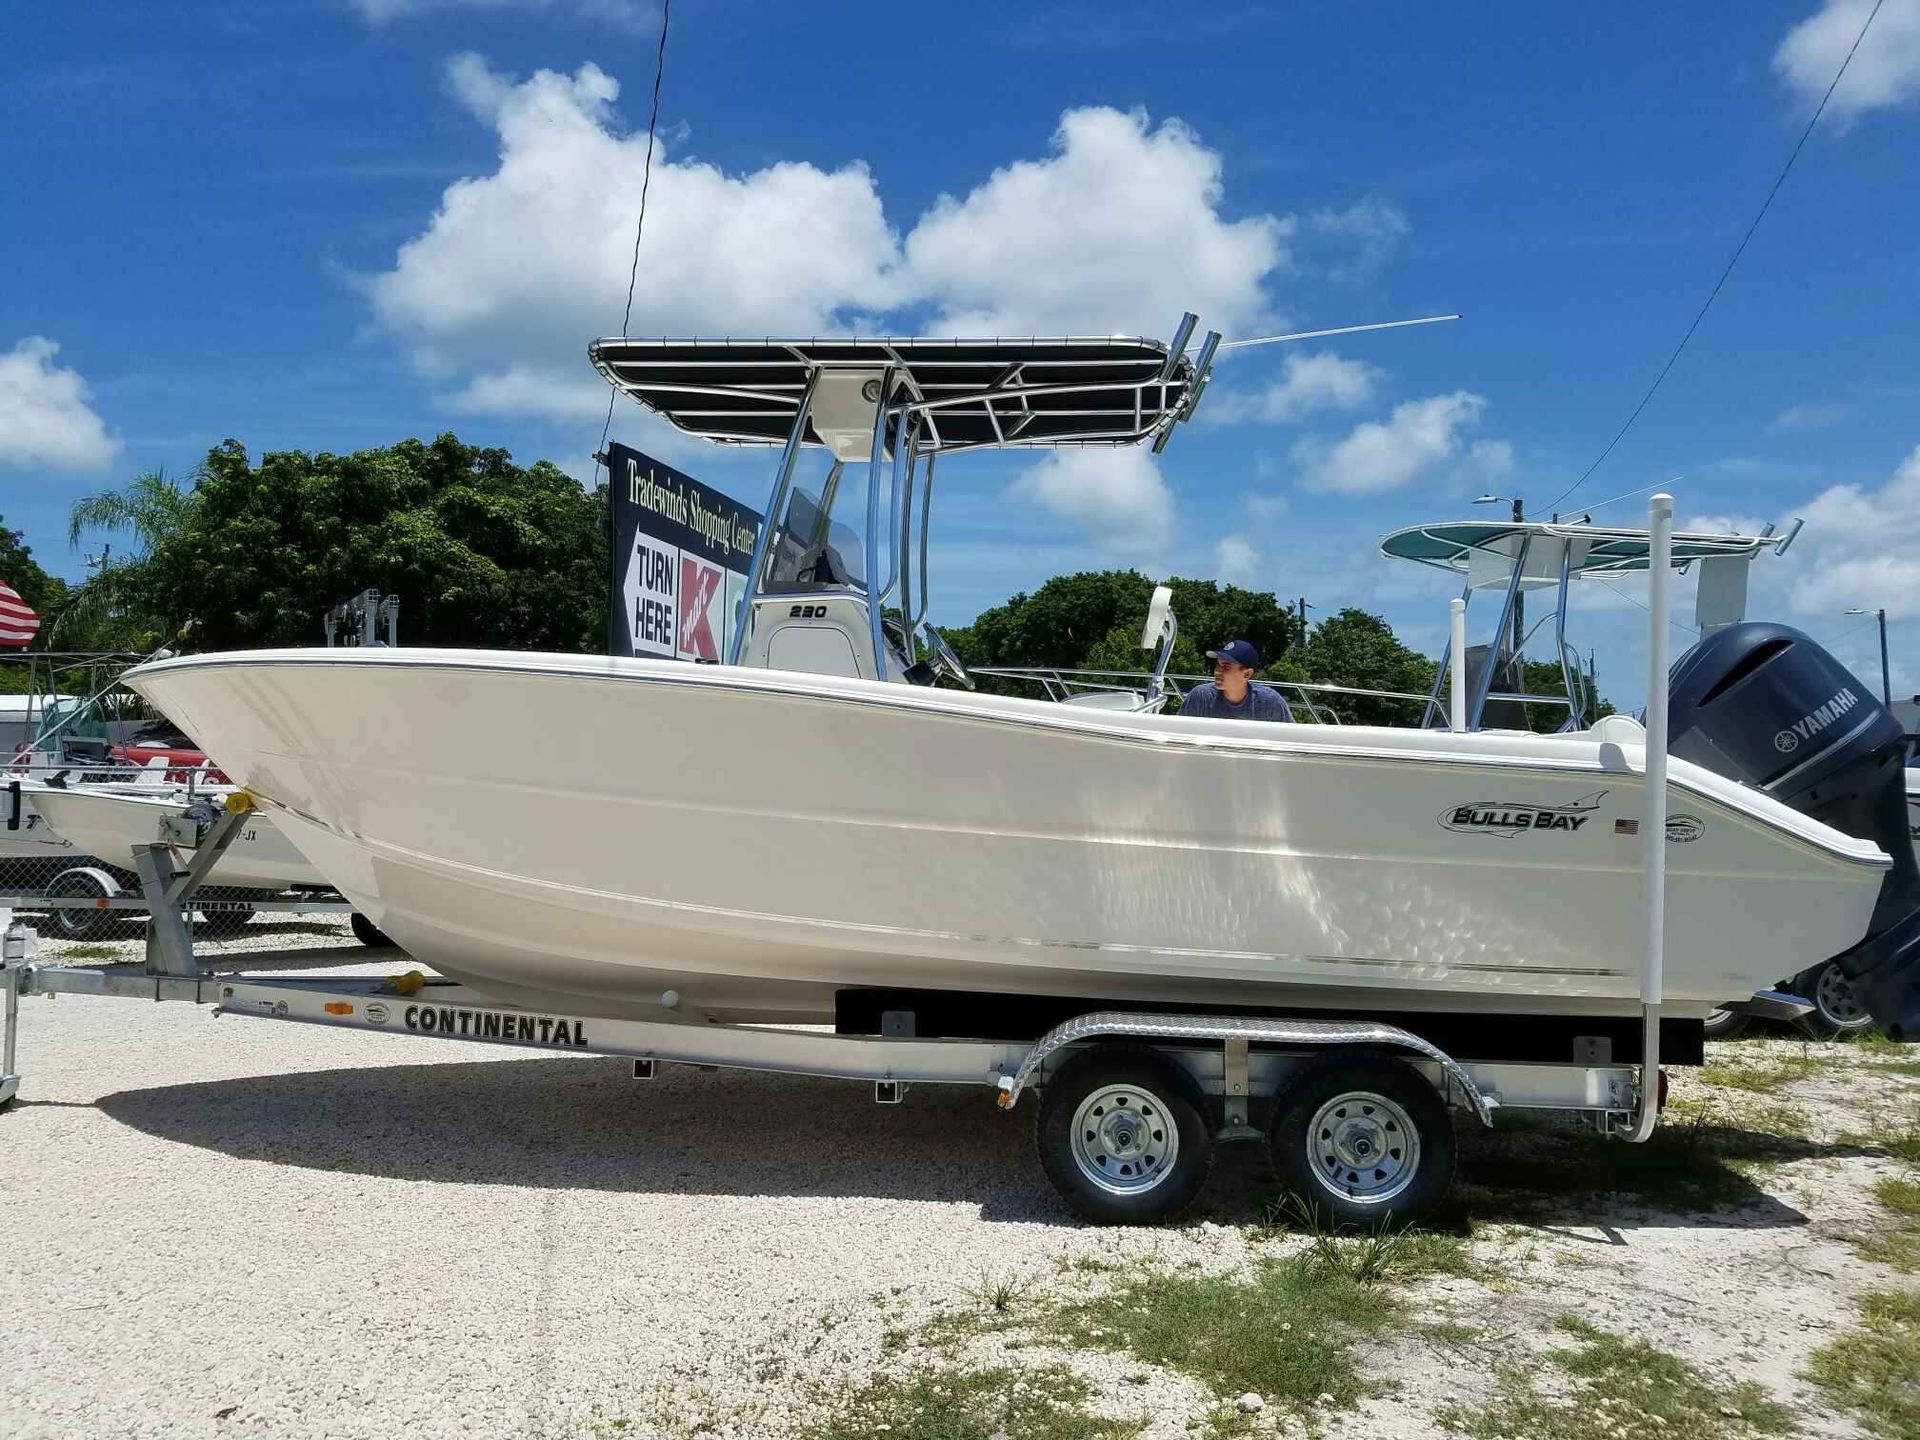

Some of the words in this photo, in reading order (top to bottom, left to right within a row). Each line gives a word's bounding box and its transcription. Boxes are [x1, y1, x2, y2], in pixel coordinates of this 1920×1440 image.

[627, 458, 688, 526] Tradewinds
[690, 489, 731, 555] Shopping
[732, 511, 756, 556] Center
[636, 544, 674, 597] TURN
[635, 596, 672, 646] HERE
[789, 605, 827, 618] 230
[1792, 687, 1859, 740] YAMAHA
[1451, 807, 1532, 828] BULLS
[1533, 811, 1588, 831] BAY
[180, 901, 255, 911] NTINENTAL
[405, 1005, 588, 1047] CONTINENTAL
